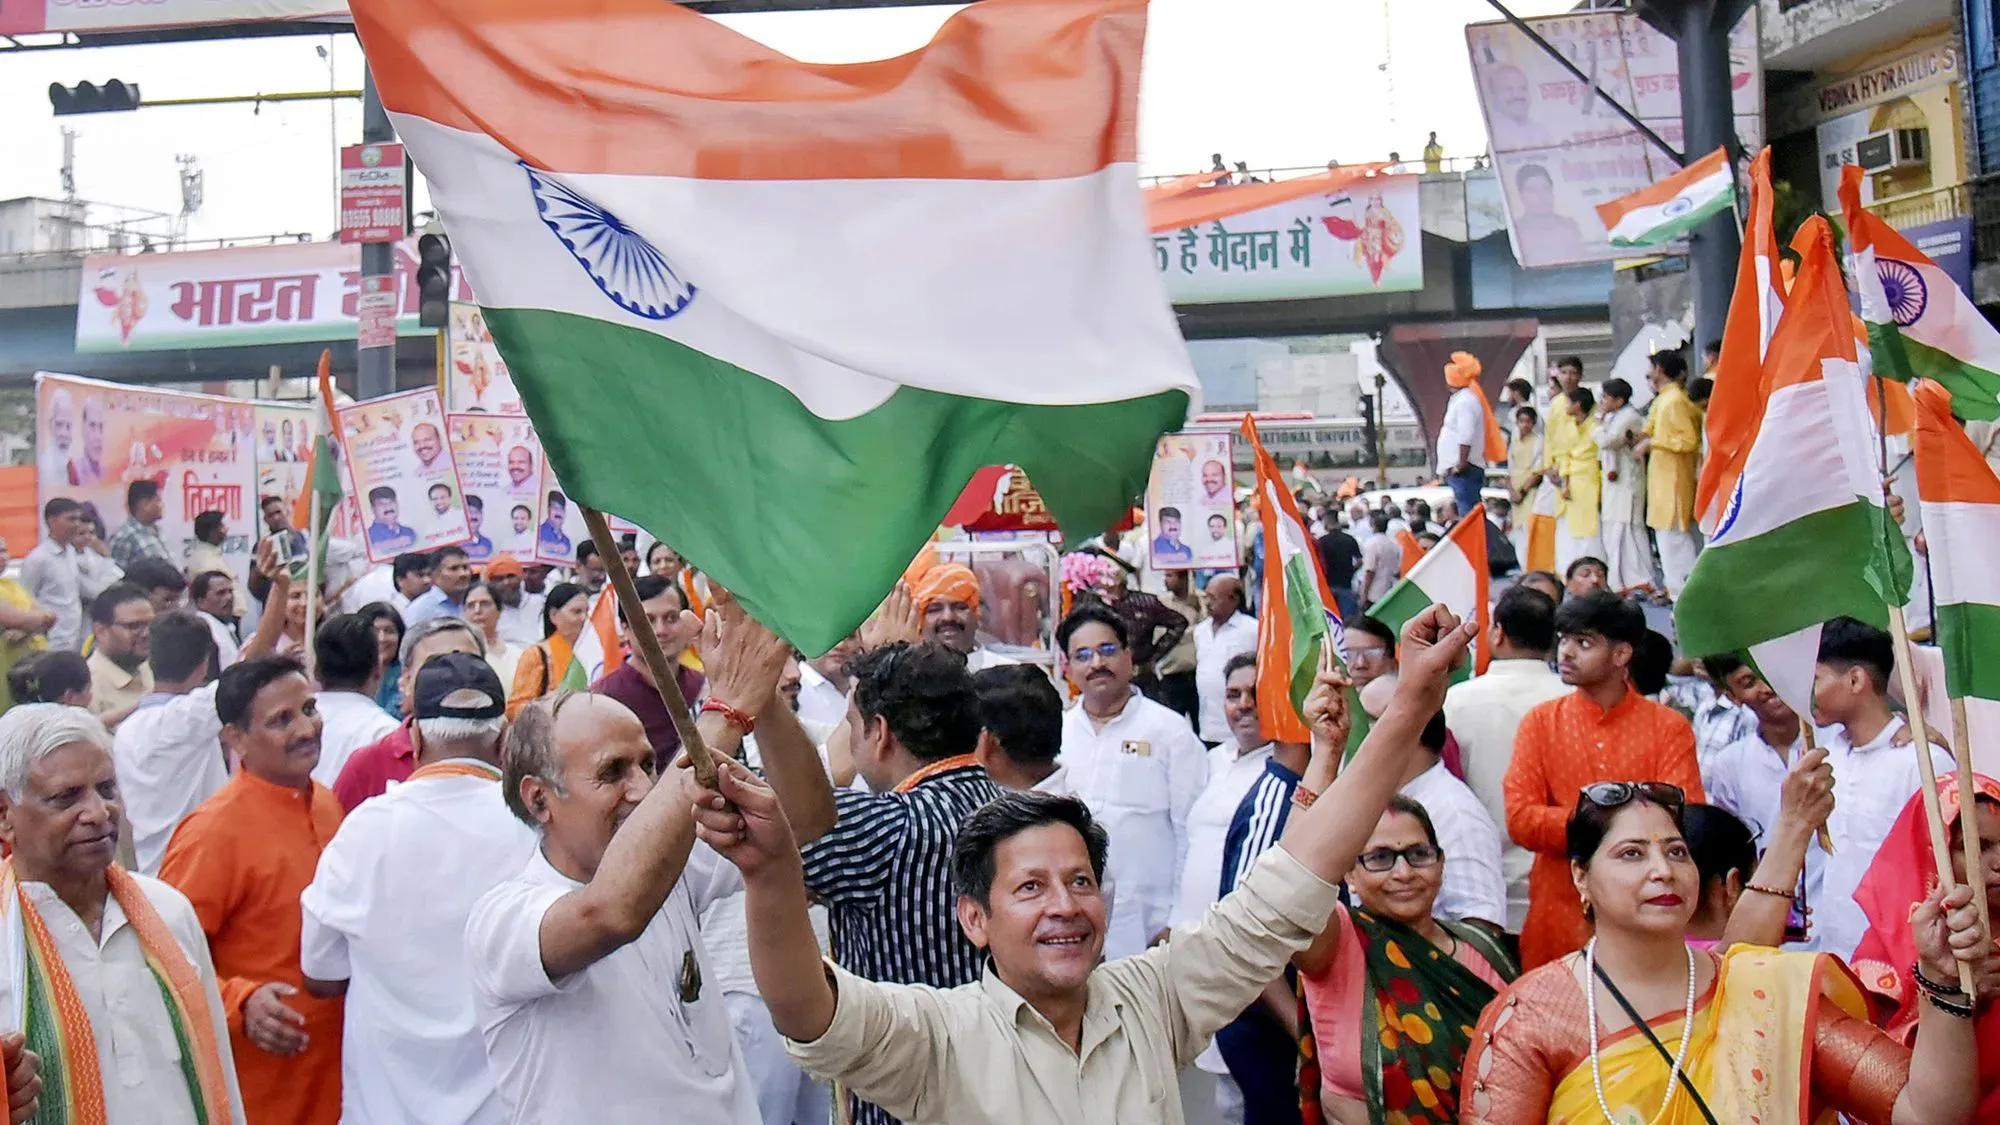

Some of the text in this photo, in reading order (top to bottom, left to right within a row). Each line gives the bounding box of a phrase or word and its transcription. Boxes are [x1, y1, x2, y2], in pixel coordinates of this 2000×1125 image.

[1818, 82, 1859, 112] VEDIKA
[1206, 219, 1279, 273] मैदान
[1287, 215, 1312, 269] में
[170, 273, 321, 326] भारत
[182, 469, 242, 523] तिरंगा
